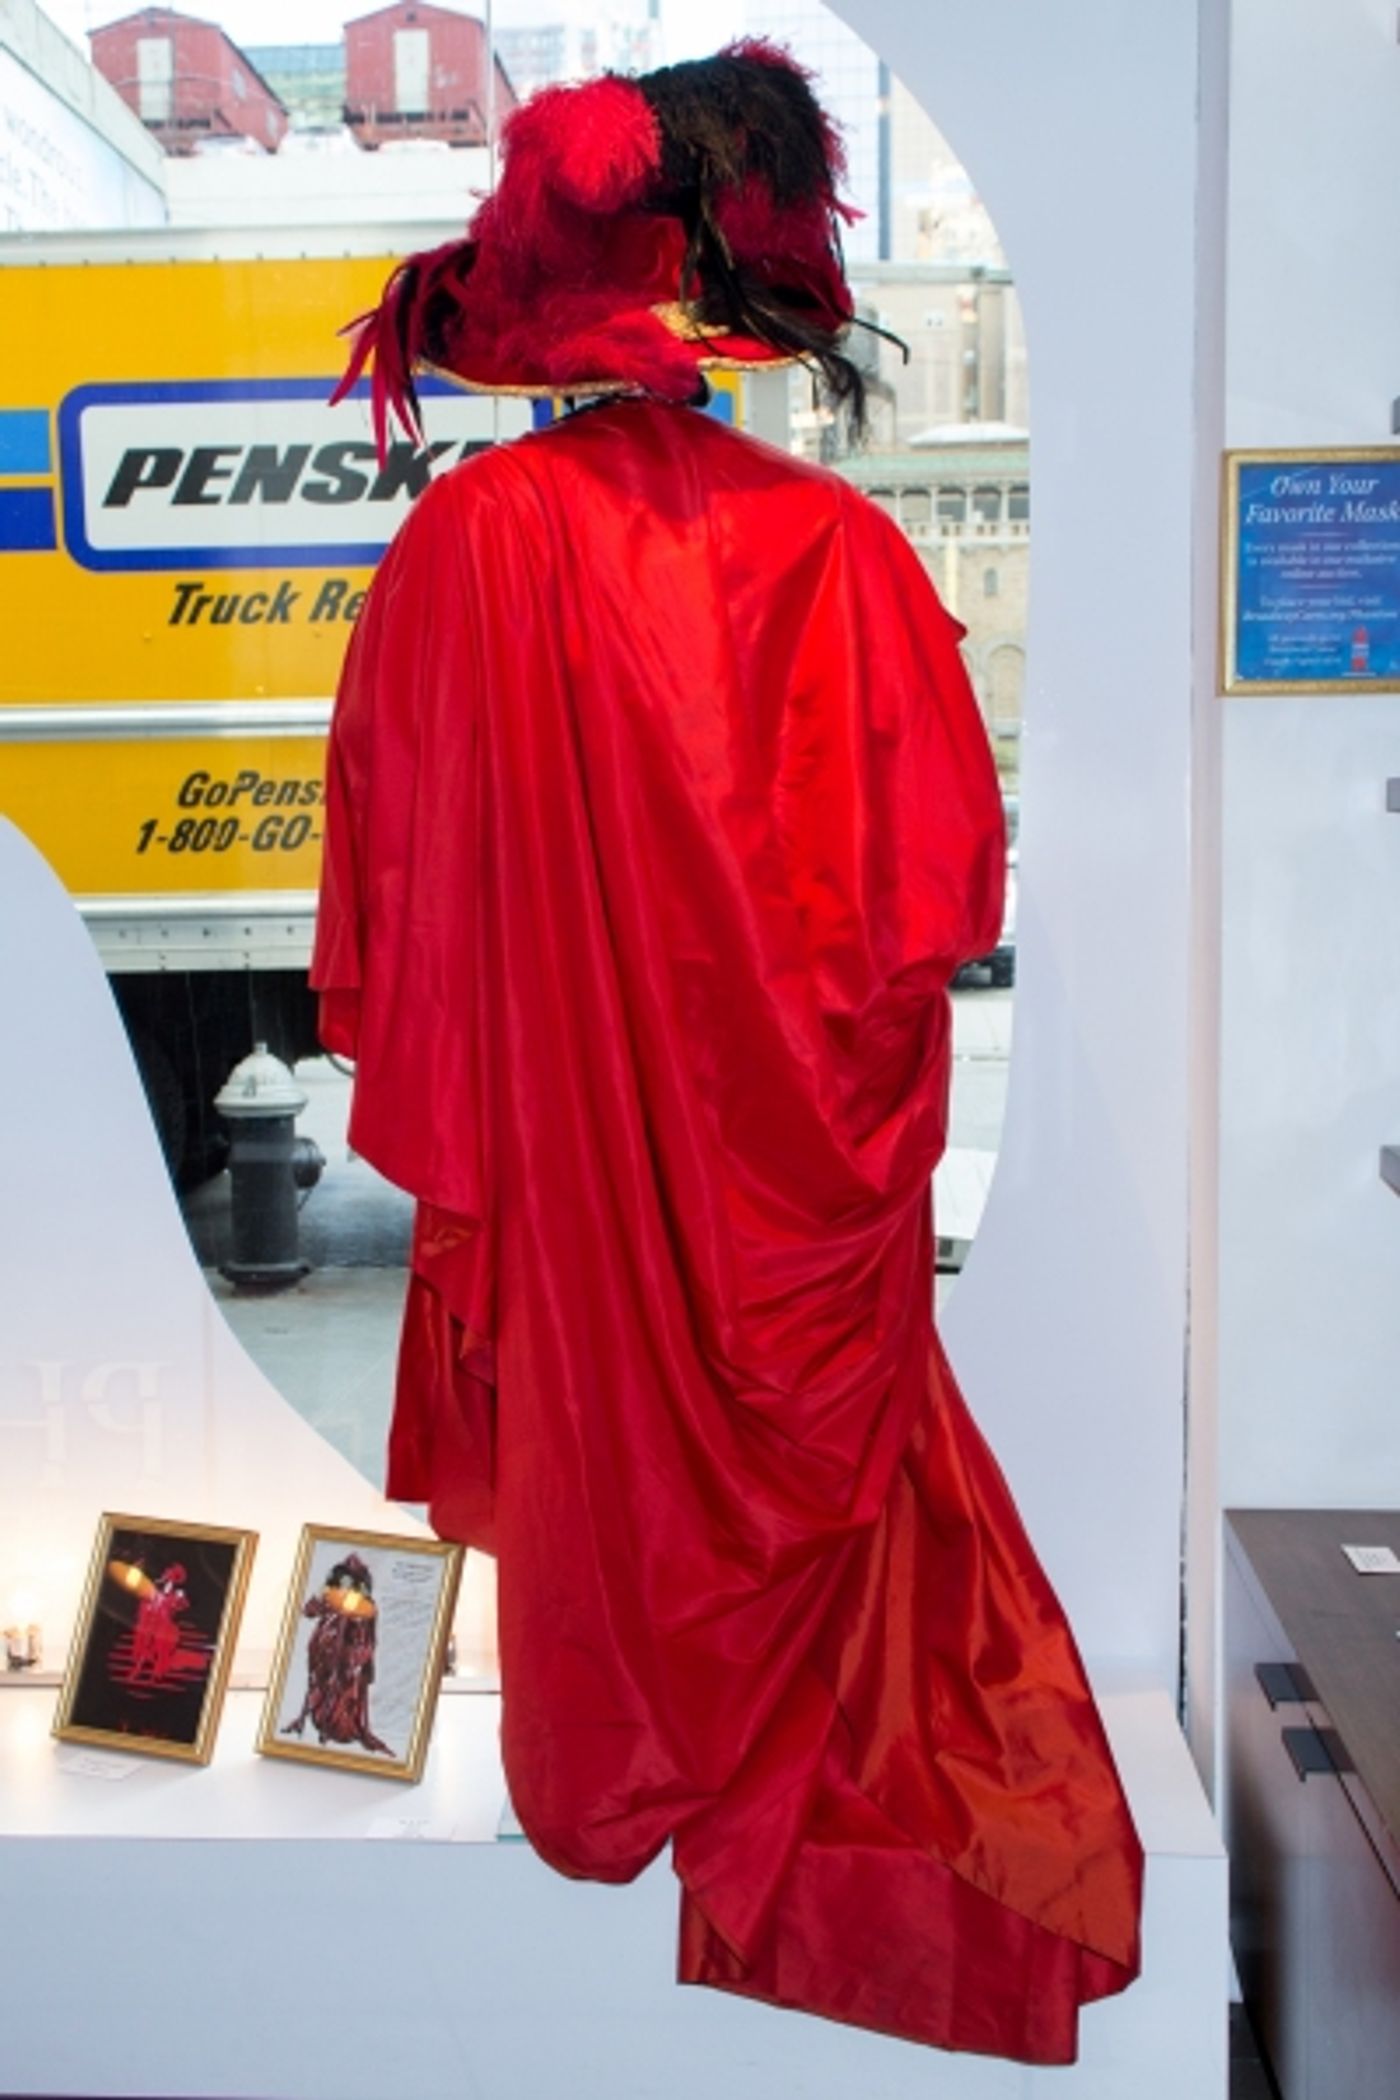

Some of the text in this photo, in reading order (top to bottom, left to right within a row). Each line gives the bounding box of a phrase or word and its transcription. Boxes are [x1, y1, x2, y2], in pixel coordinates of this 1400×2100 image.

[102, 440, 500, 508] PENSK
[1270, 473, 1381, 498] Own Your
[1244, 500, 1338, 526] Favorite
[169, 578, 371, 625] Truck Re
[177, 770, 325, 807] GoPens
[136, 814, 322, 854] 1-800-GO-
